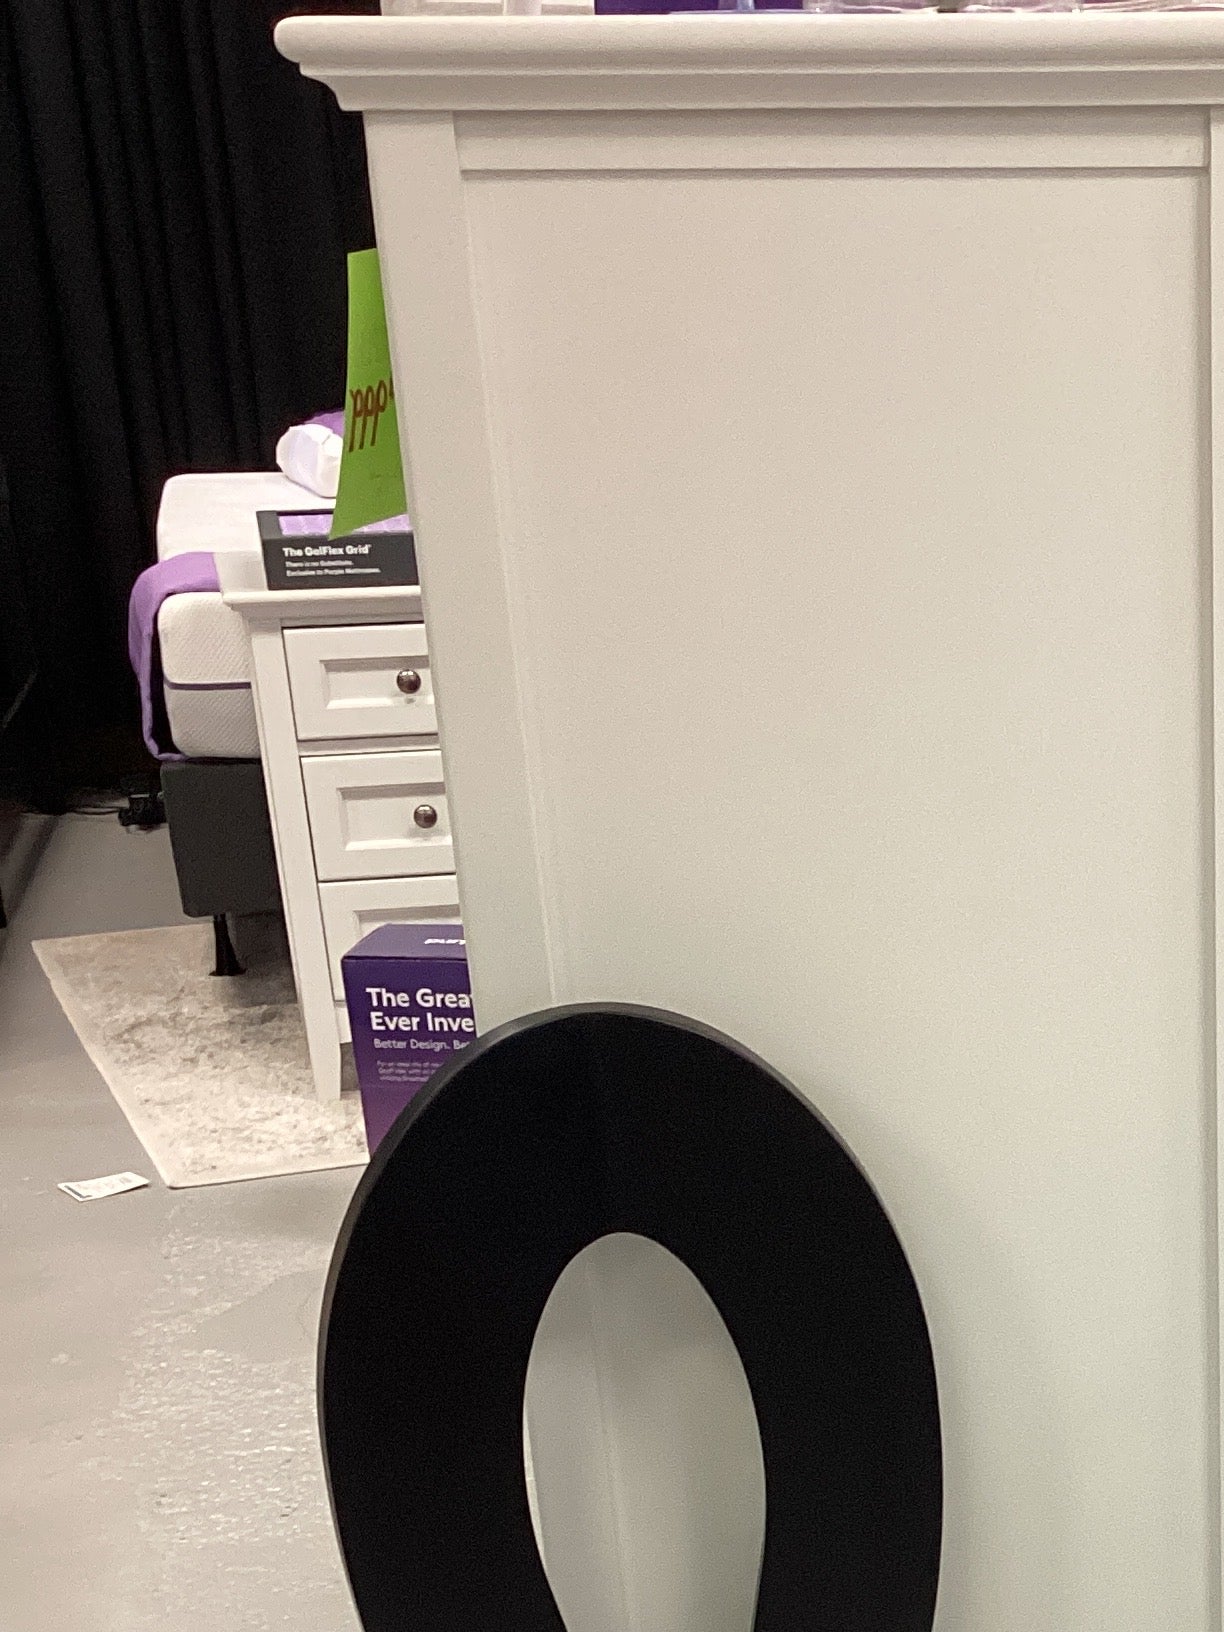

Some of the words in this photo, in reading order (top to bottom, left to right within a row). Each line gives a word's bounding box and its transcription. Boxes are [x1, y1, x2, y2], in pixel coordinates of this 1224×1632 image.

[283, 547, 303, 557] The
[304, 545, 344, 556] GelFlex
[345, 545, 370, 555] Grid
[365, 987, 410, 1008] The
[415, 988, 472, 1008] Grea
[370, 1012, 420, 1031] Ever
[373, 1038, 407, 1050] Better
[410, 1039, 450, 1052] Design.
